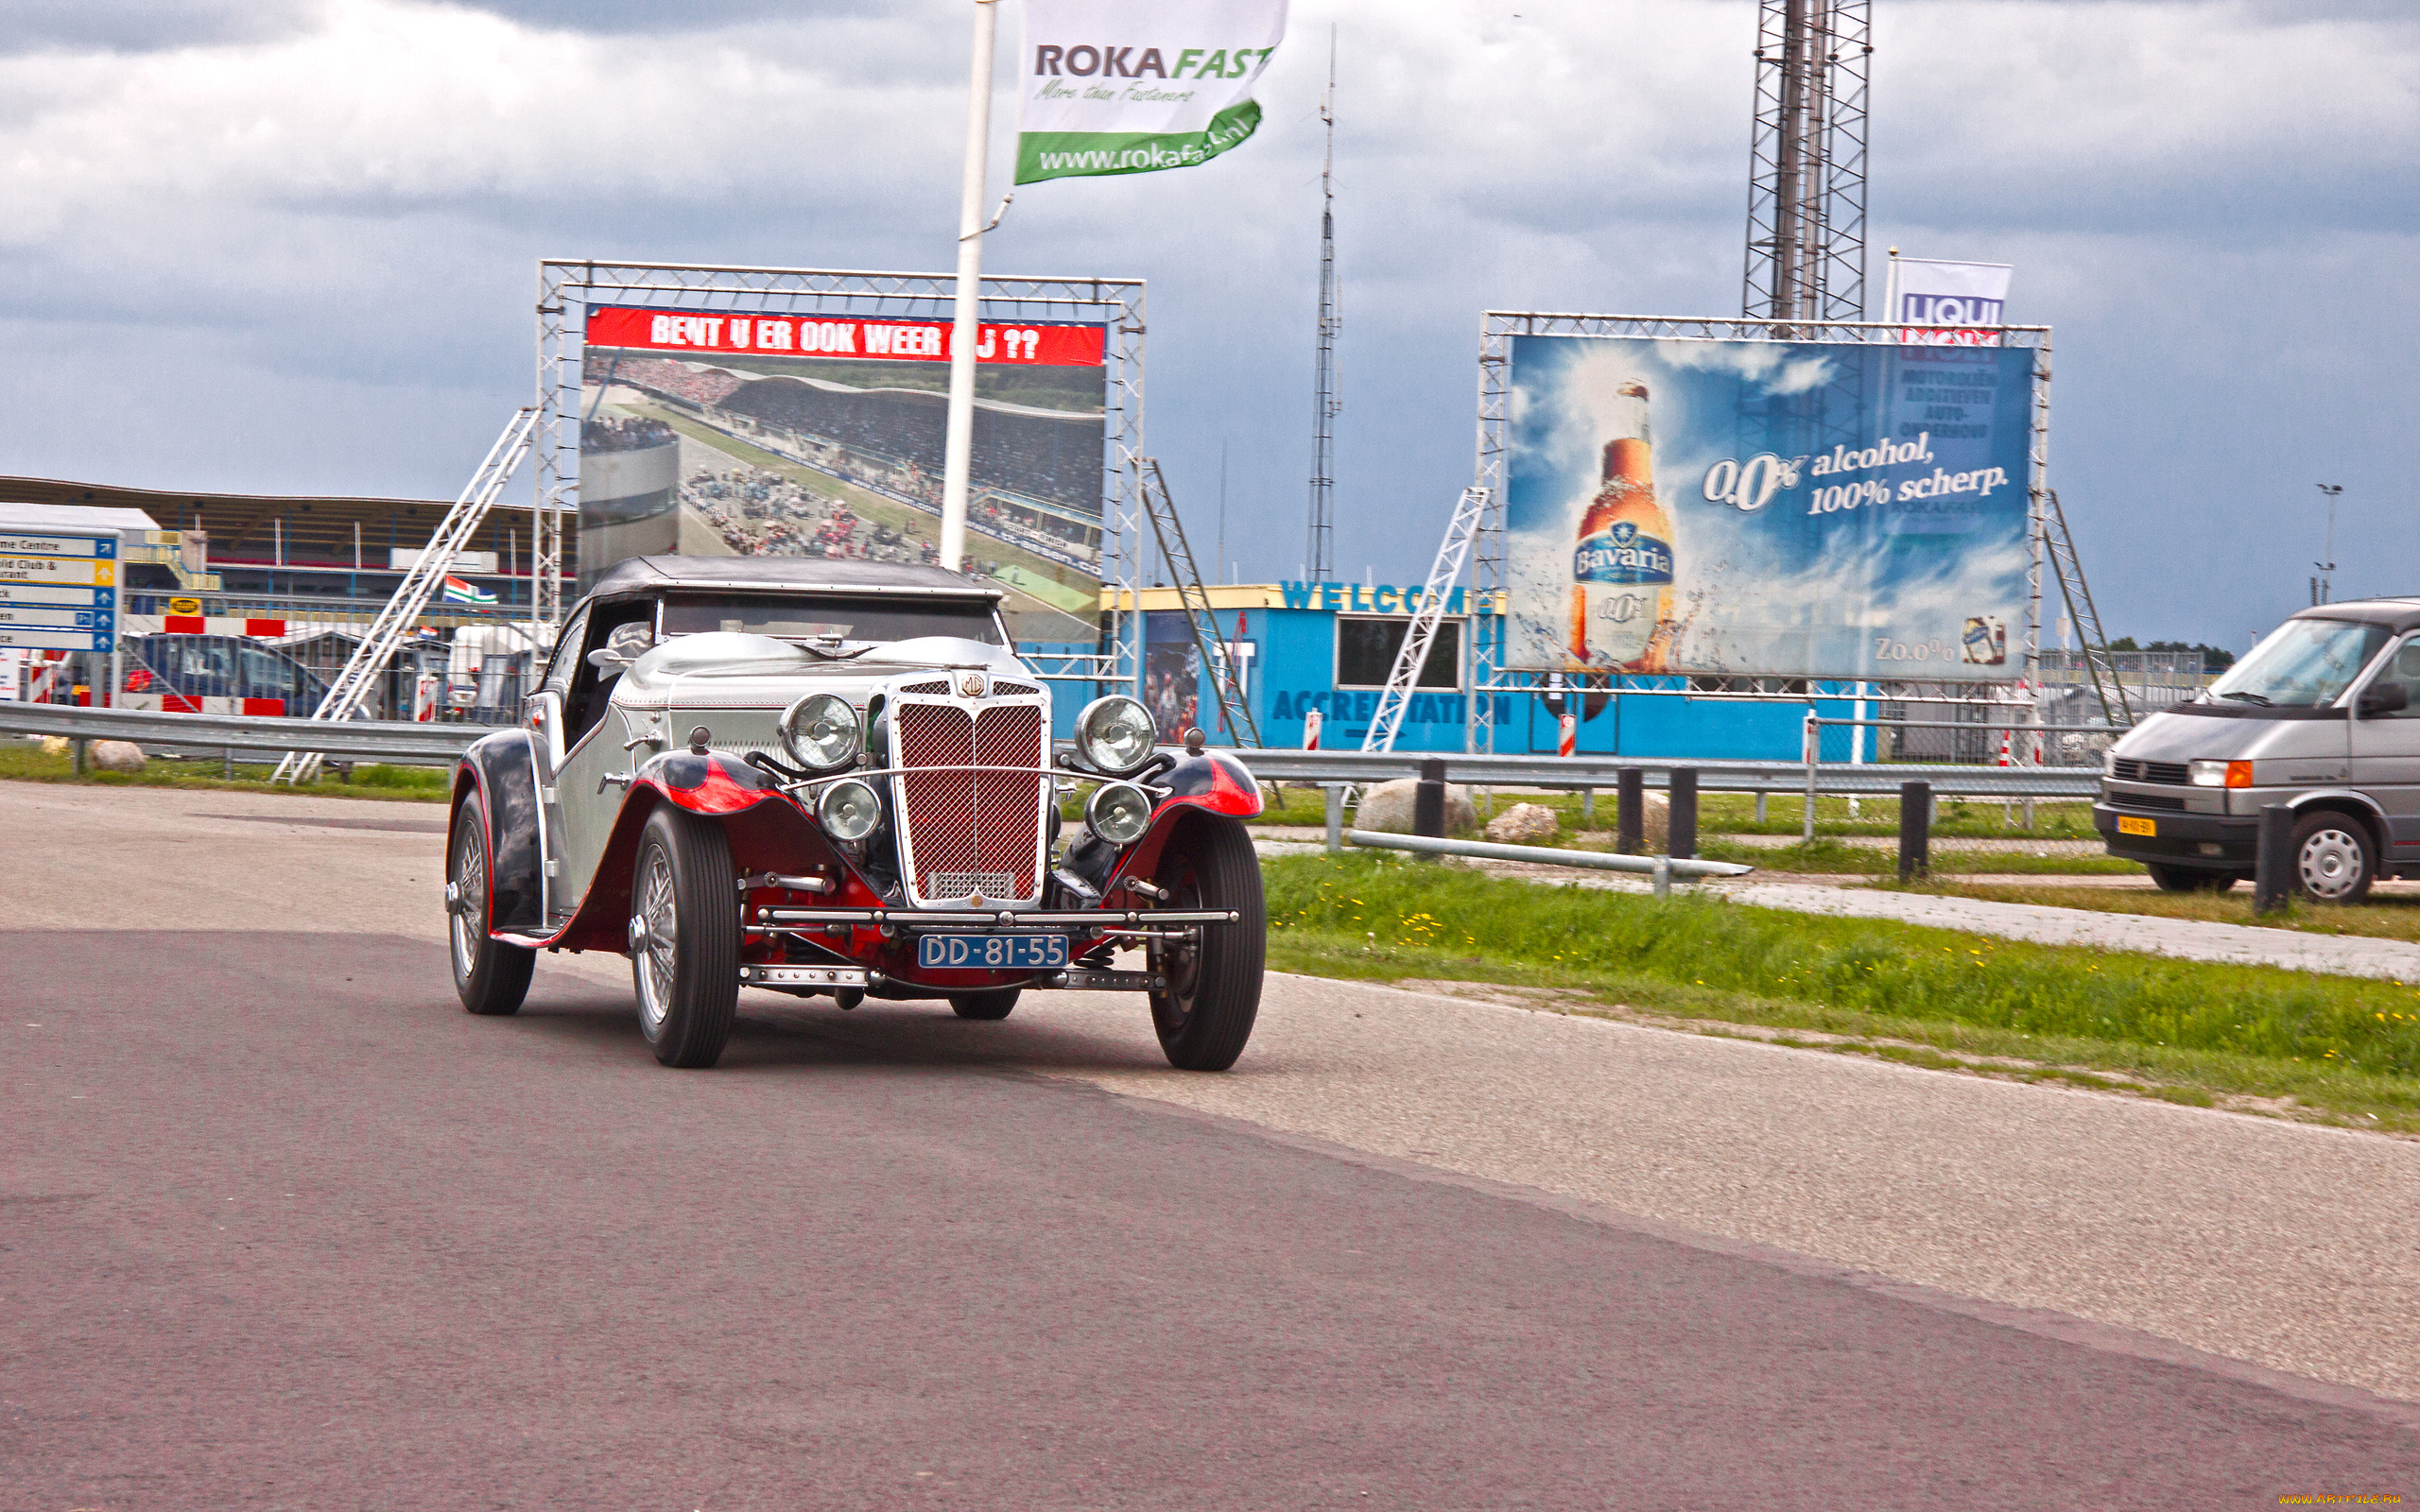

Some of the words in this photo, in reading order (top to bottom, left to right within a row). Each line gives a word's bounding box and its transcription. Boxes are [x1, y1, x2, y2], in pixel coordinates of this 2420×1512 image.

[1034, 78, 1077, 99] More
[1083, 81, 1115, 100] than
[1119, 81, 1195, 102] Fasteners
[1907, 297, 2001, 325] LIQUI
[651, 315, 724, 347] BENT
[730, 318, 751, 349] U
[756, 320, 793, 350] ER
[800, 321, 856, 352] OOK
[864, 324, 942, 355] WEER
[1003, 329, 1040, 359] ??
[1703, 452, 1810, 513] 0.0%
[1810, 432, 1935, 476] alcohol,
[1806, 479, 1891, 515] 100%
[1896, 467, 2010, 502] scherp.
[20, 540, 60, 551] Centre
[17, 559, 43, 570] Club
[47, 560, 56, 570] &
[1576, 547, 1670, 575] Bavaria
[964, 676, 982, 694] MG
[926, 938, 1063, 965] DD-81-55
